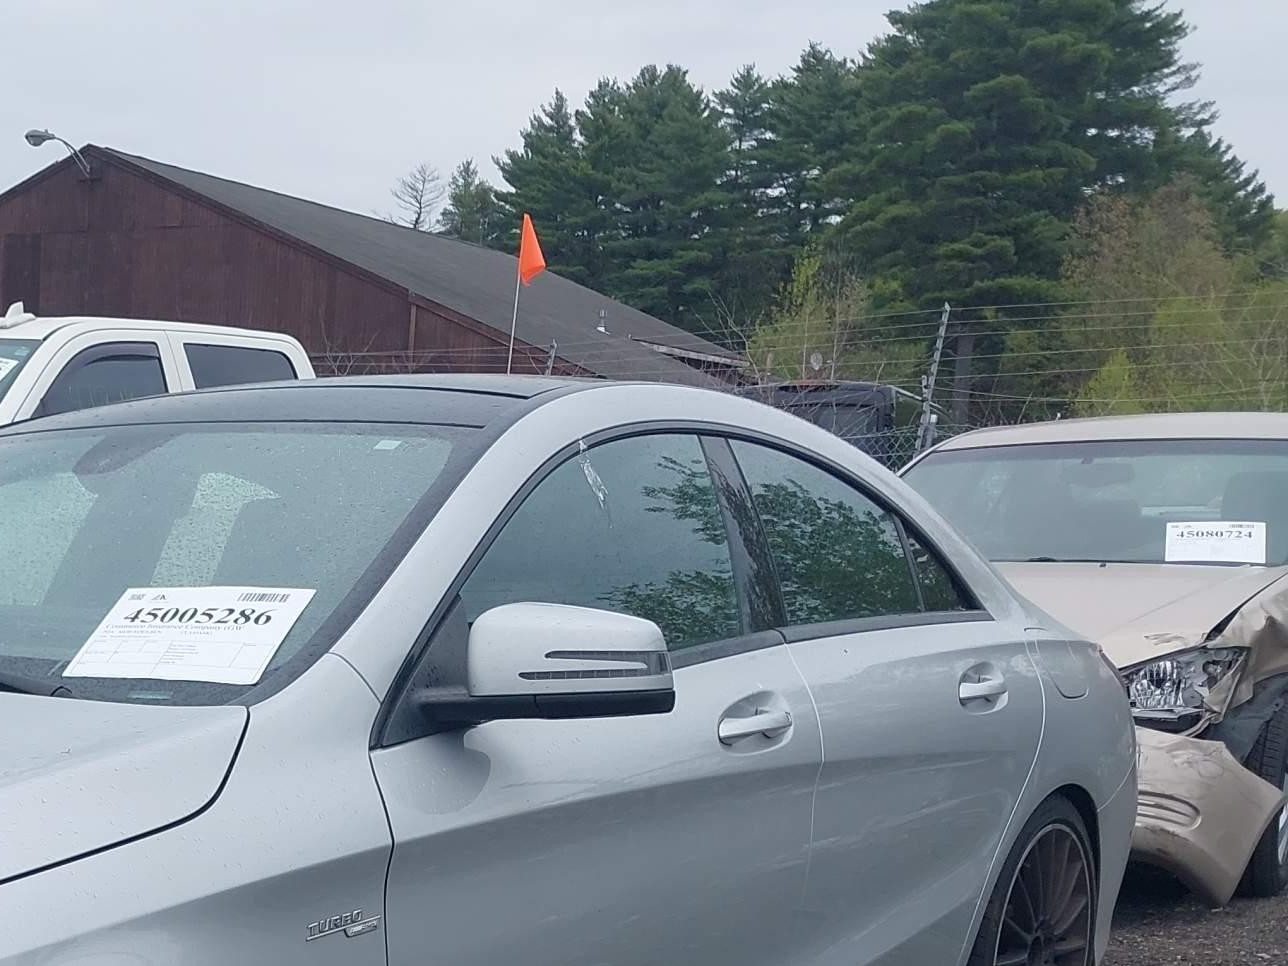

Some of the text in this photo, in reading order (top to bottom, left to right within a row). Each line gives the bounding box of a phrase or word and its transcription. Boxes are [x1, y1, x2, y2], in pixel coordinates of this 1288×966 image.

[1176, 530, 1253, 539] 45080724
[124, 607, 278, 626] 45005286
[307, 909, 362, 936] TURBO
